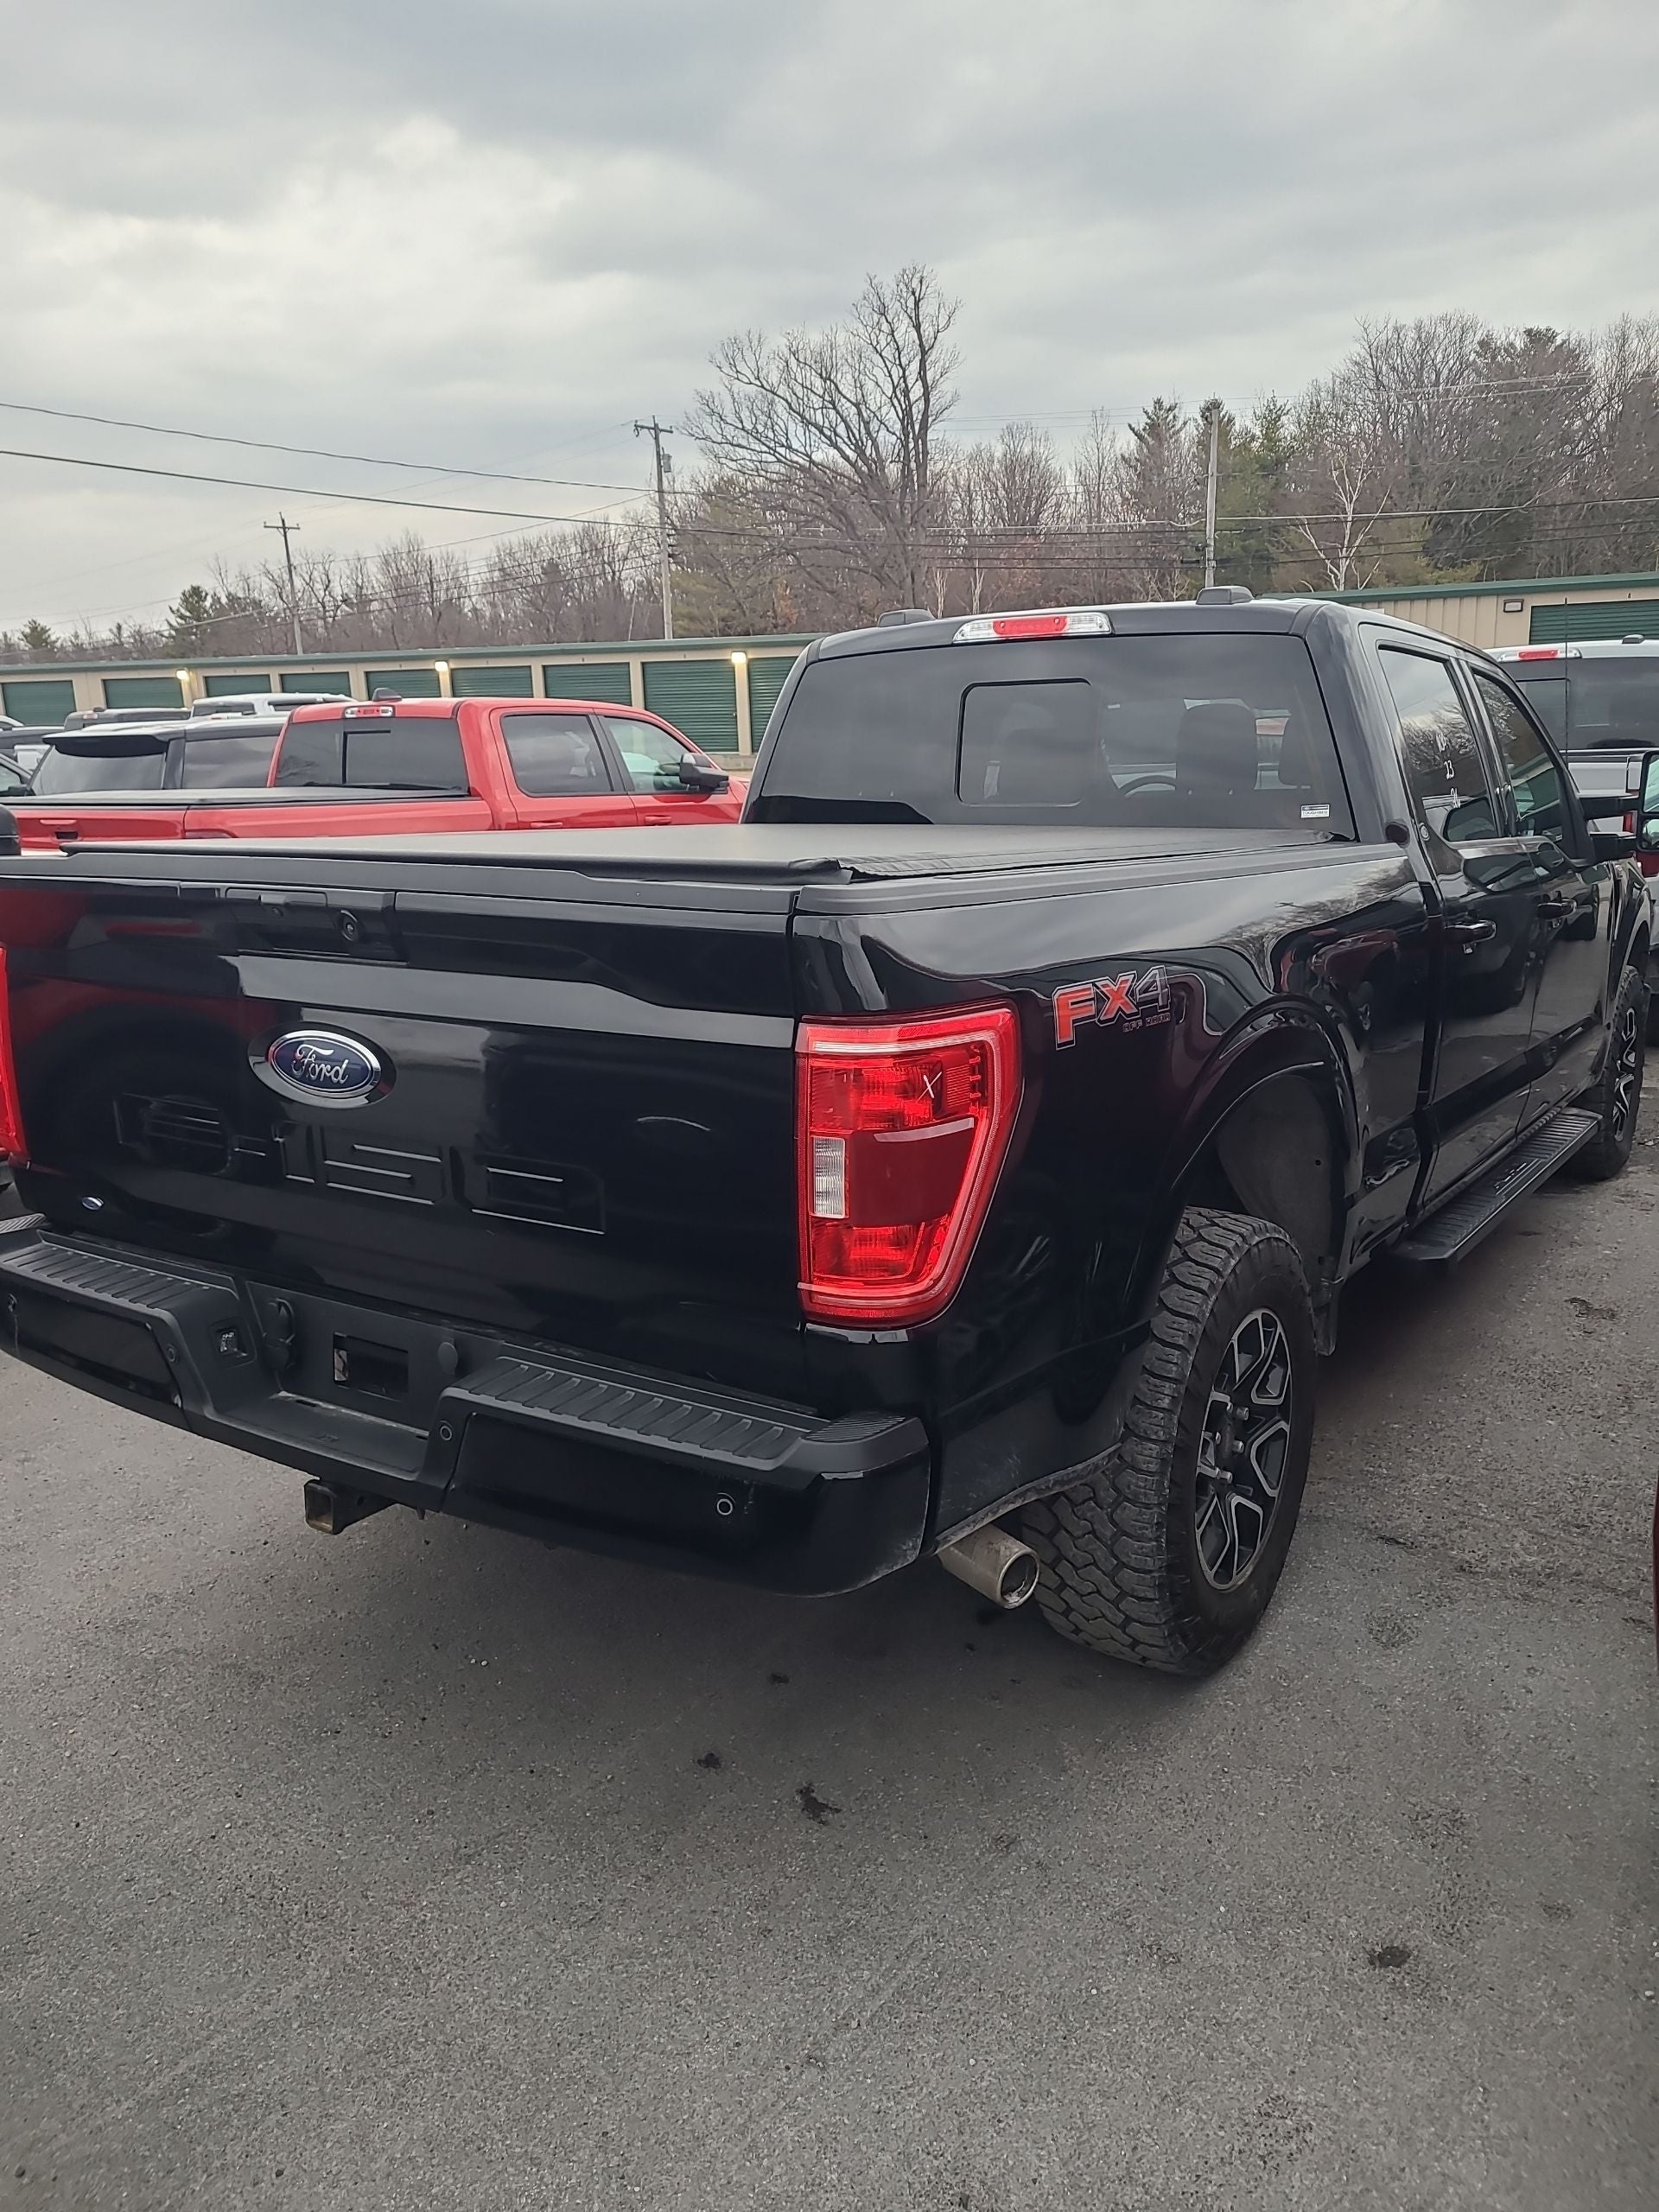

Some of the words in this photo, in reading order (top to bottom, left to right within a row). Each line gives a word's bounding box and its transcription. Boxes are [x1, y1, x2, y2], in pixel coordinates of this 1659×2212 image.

[1052, 964, 1171, 1051] FX4
[1123, 1019, 1143, 1033] OFF
[1146, 1012, 1171, 1027] ROAD
[291, 1043, 349, 1085] Ford
